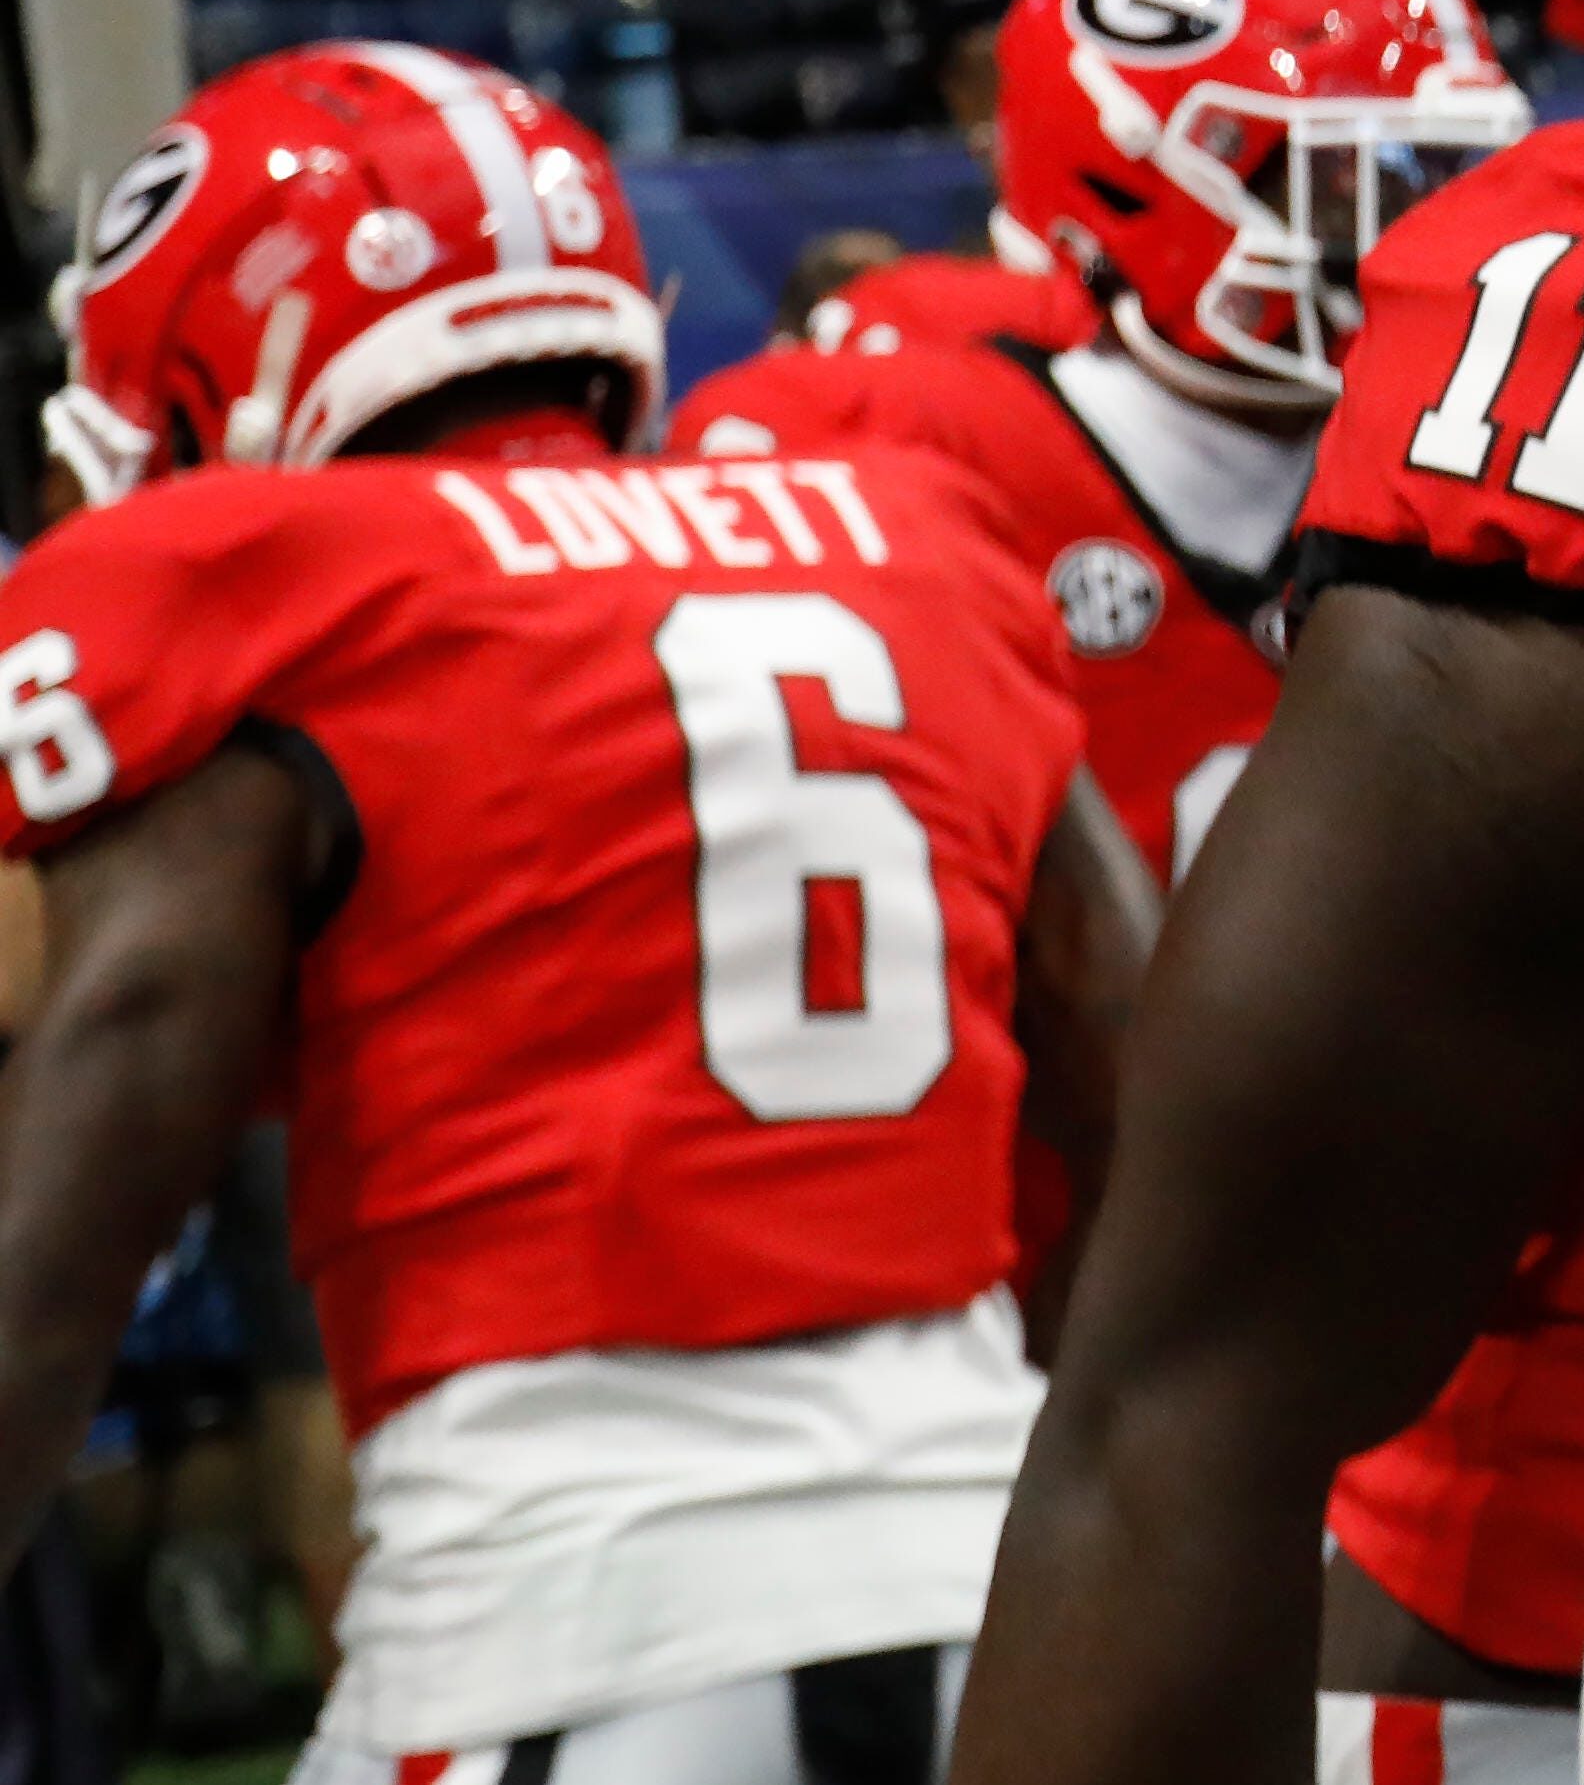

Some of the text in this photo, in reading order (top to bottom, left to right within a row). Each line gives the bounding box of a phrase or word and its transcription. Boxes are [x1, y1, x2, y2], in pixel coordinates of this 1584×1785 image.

[436, 460, 890, 577] LOVETT
[0, 627, 117, 822] 6
[652, 592, 953, 1122] 6
